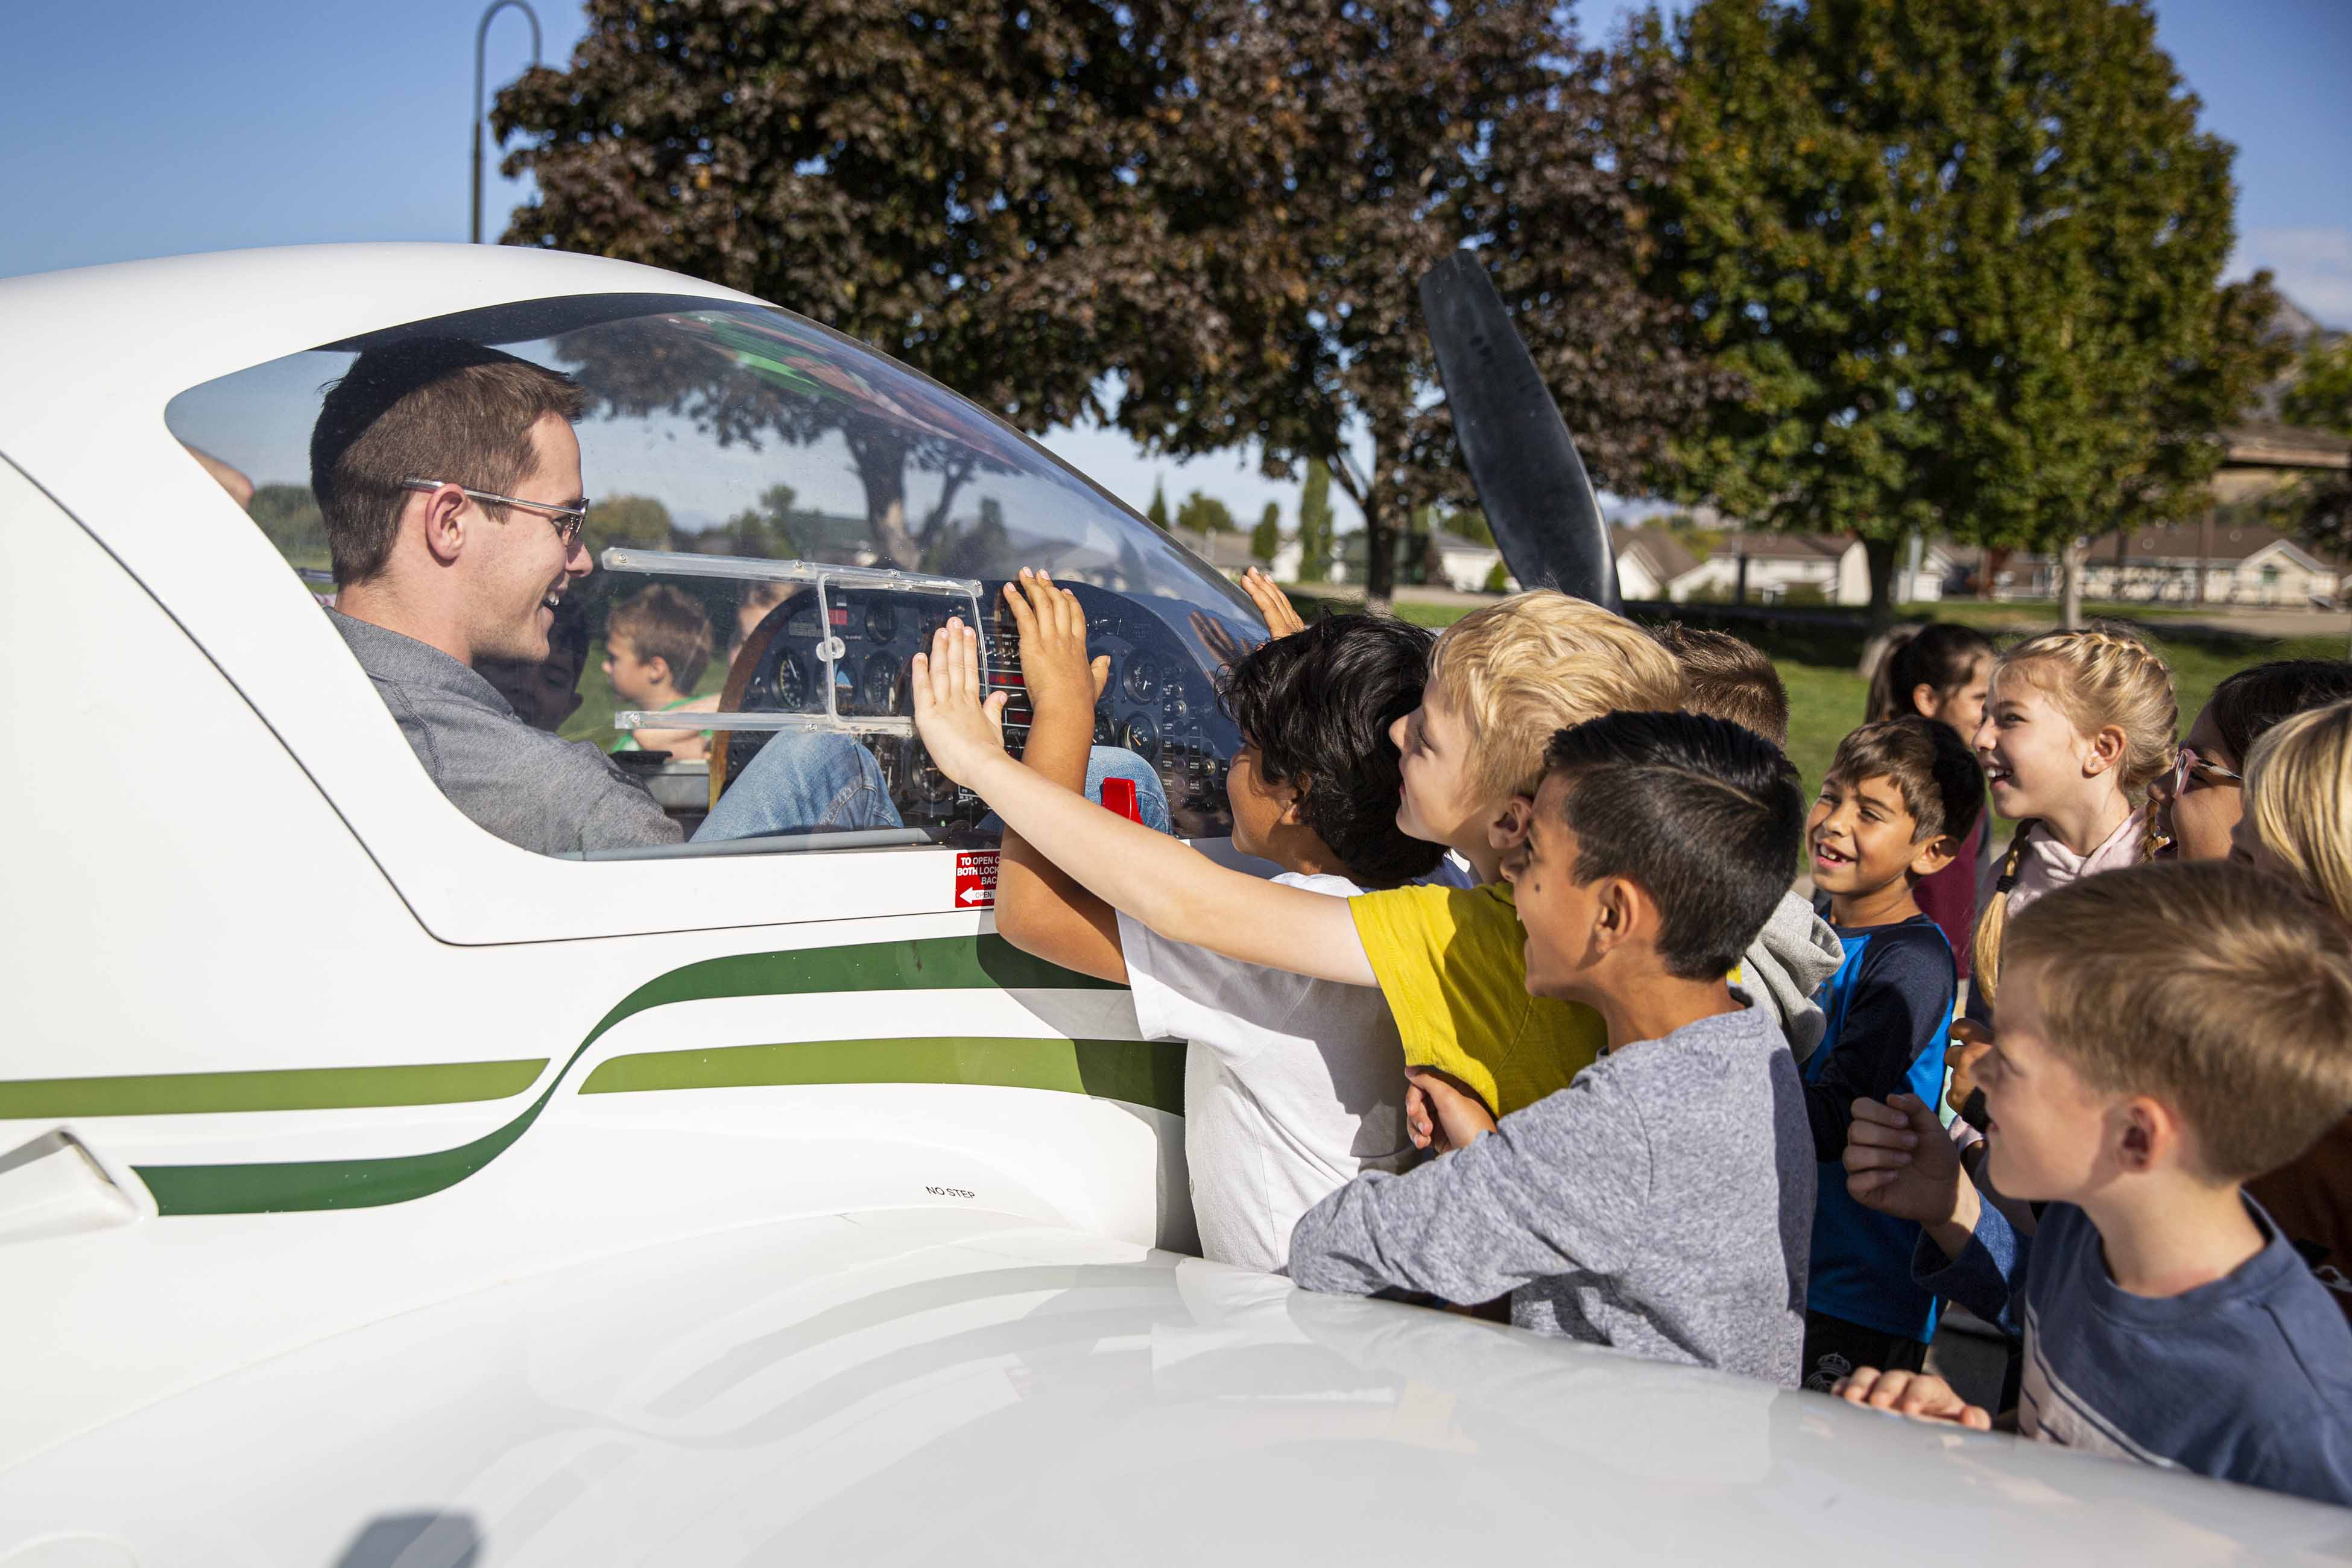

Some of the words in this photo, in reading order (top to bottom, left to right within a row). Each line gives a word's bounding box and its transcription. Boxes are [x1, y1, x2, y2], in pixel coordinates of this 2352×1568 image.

[960, 857, 972, 866] TO
[973, 856, 993, 865] OPEN
[957, 867, 978, 876] BOTH
[981, 876, 998, 885] BAC
[926, 1186, 945, 1195] NO
[946, 1188, 975, 1199] STEP
